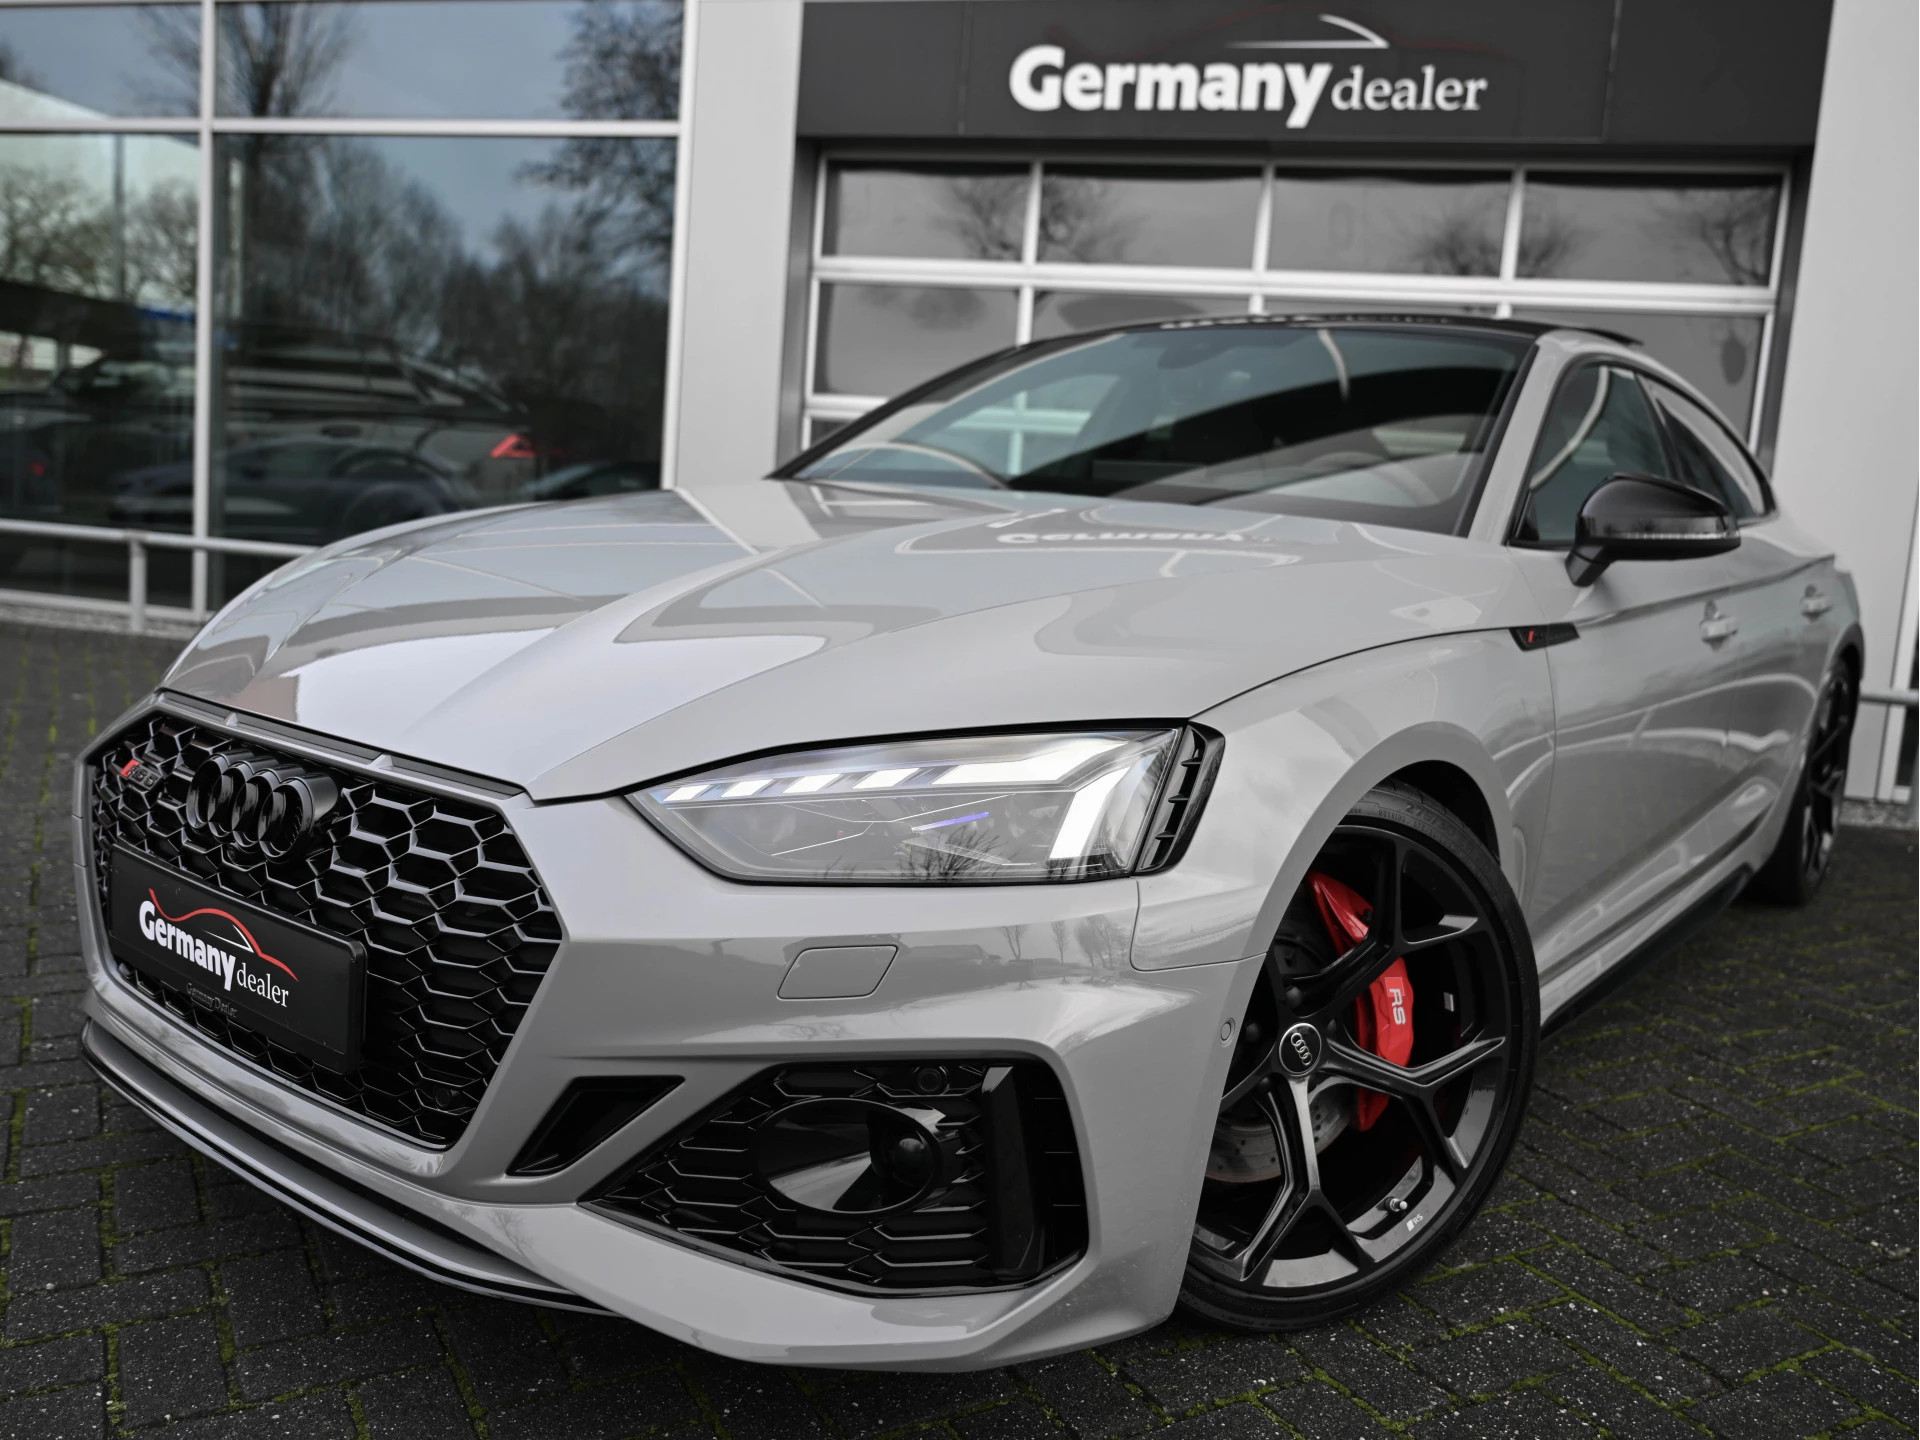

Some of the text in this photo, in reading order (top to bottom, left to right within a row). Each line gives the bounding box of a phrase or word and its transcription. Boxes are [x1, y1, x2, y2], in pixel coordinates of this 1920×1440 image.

[1009, 44, 1489, 129] Germany dealer
[139, 900, 289, 1008] Germany dealer
[1389, 988, 1407, 1025] RS
[1412, 1213, 1424, 1225] RS
